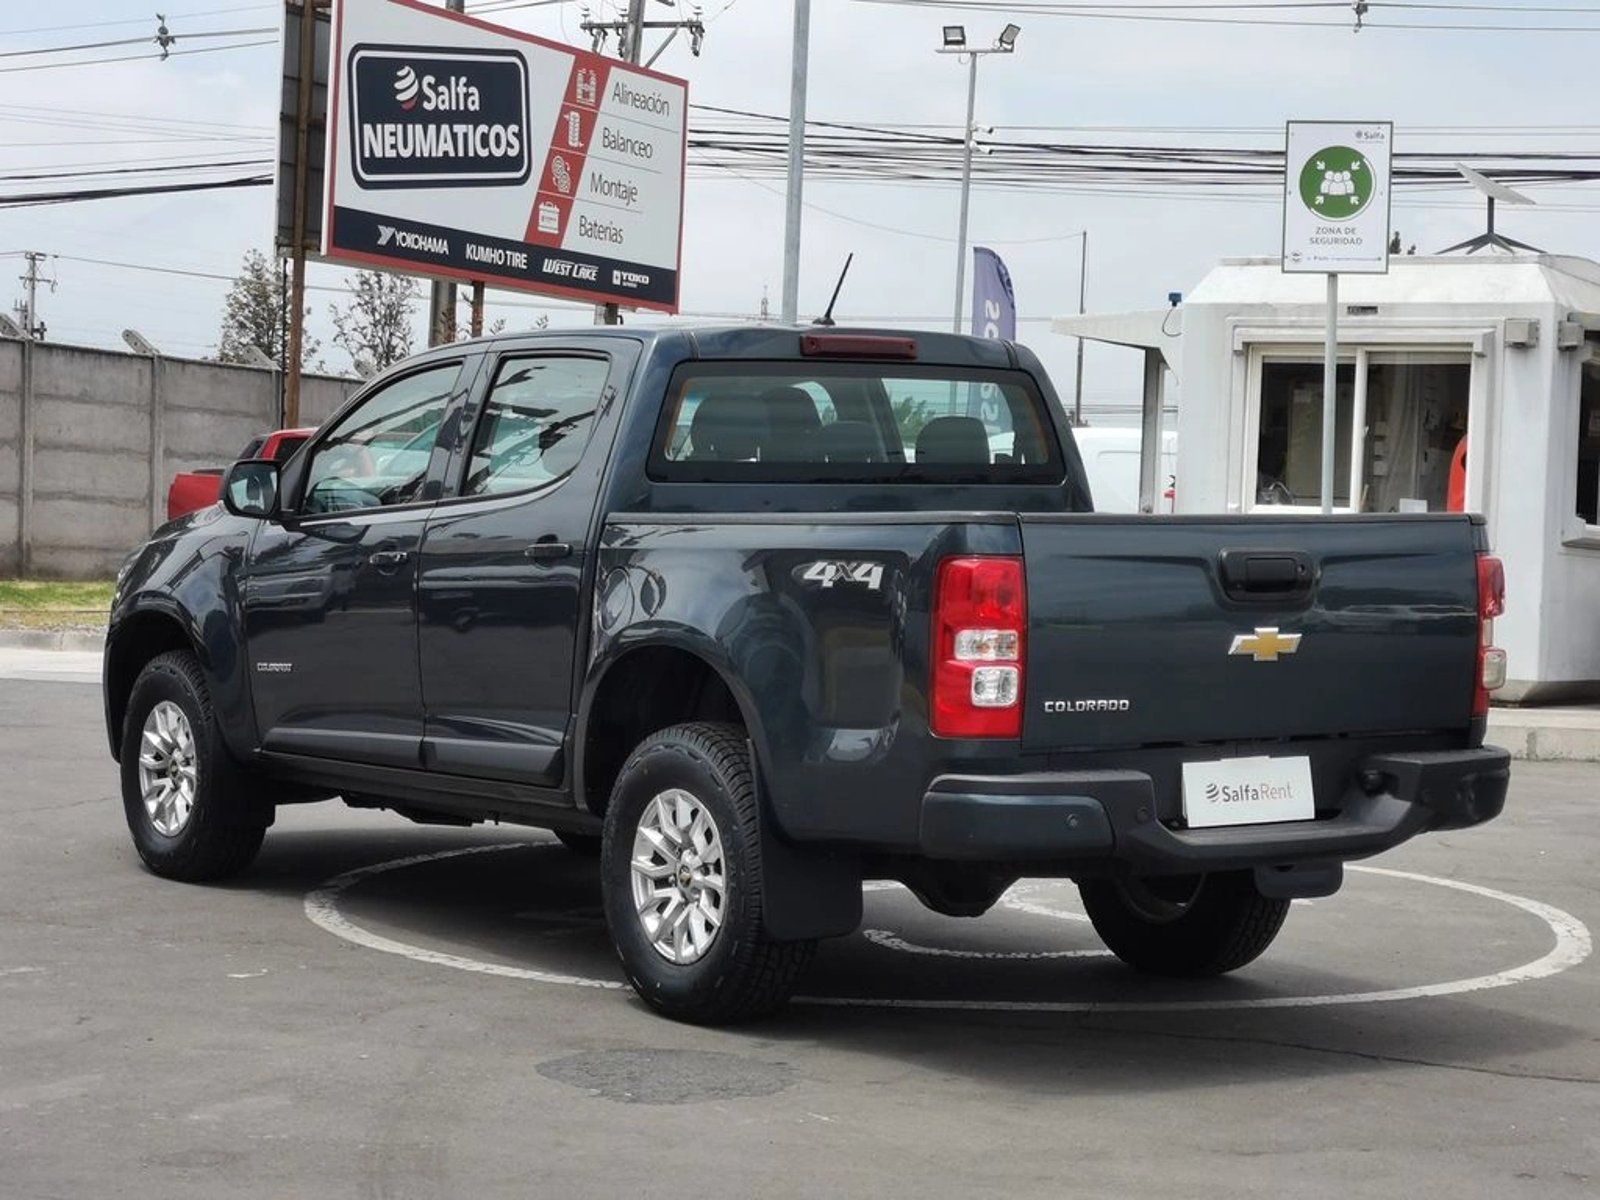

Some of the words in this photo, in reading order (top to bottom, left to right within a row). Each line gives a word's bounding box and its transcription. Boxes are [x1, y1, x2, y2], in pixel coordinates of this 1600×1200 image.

[421, 74, 480, 111] Salfa
[612, 82, 670, 117] Alineación
[363, 123, 520, 158] NEUMATICOS
[602, 127, 653, 158] Balanceo
[590, 172, 638, 206] Montaje
[395, 231, 449, 255] YOKOHAMA
[1309, 237, 1363, 246] SEGURIDAD
[1316, 226, 1342, 235] ZONA
[1344, 227, 1357, 235] DE
[465, 243, 505, 265] KUMHO
[506, 250, 528, 269] TIRE
[1044, 699, 1130, 713] COLORADO
